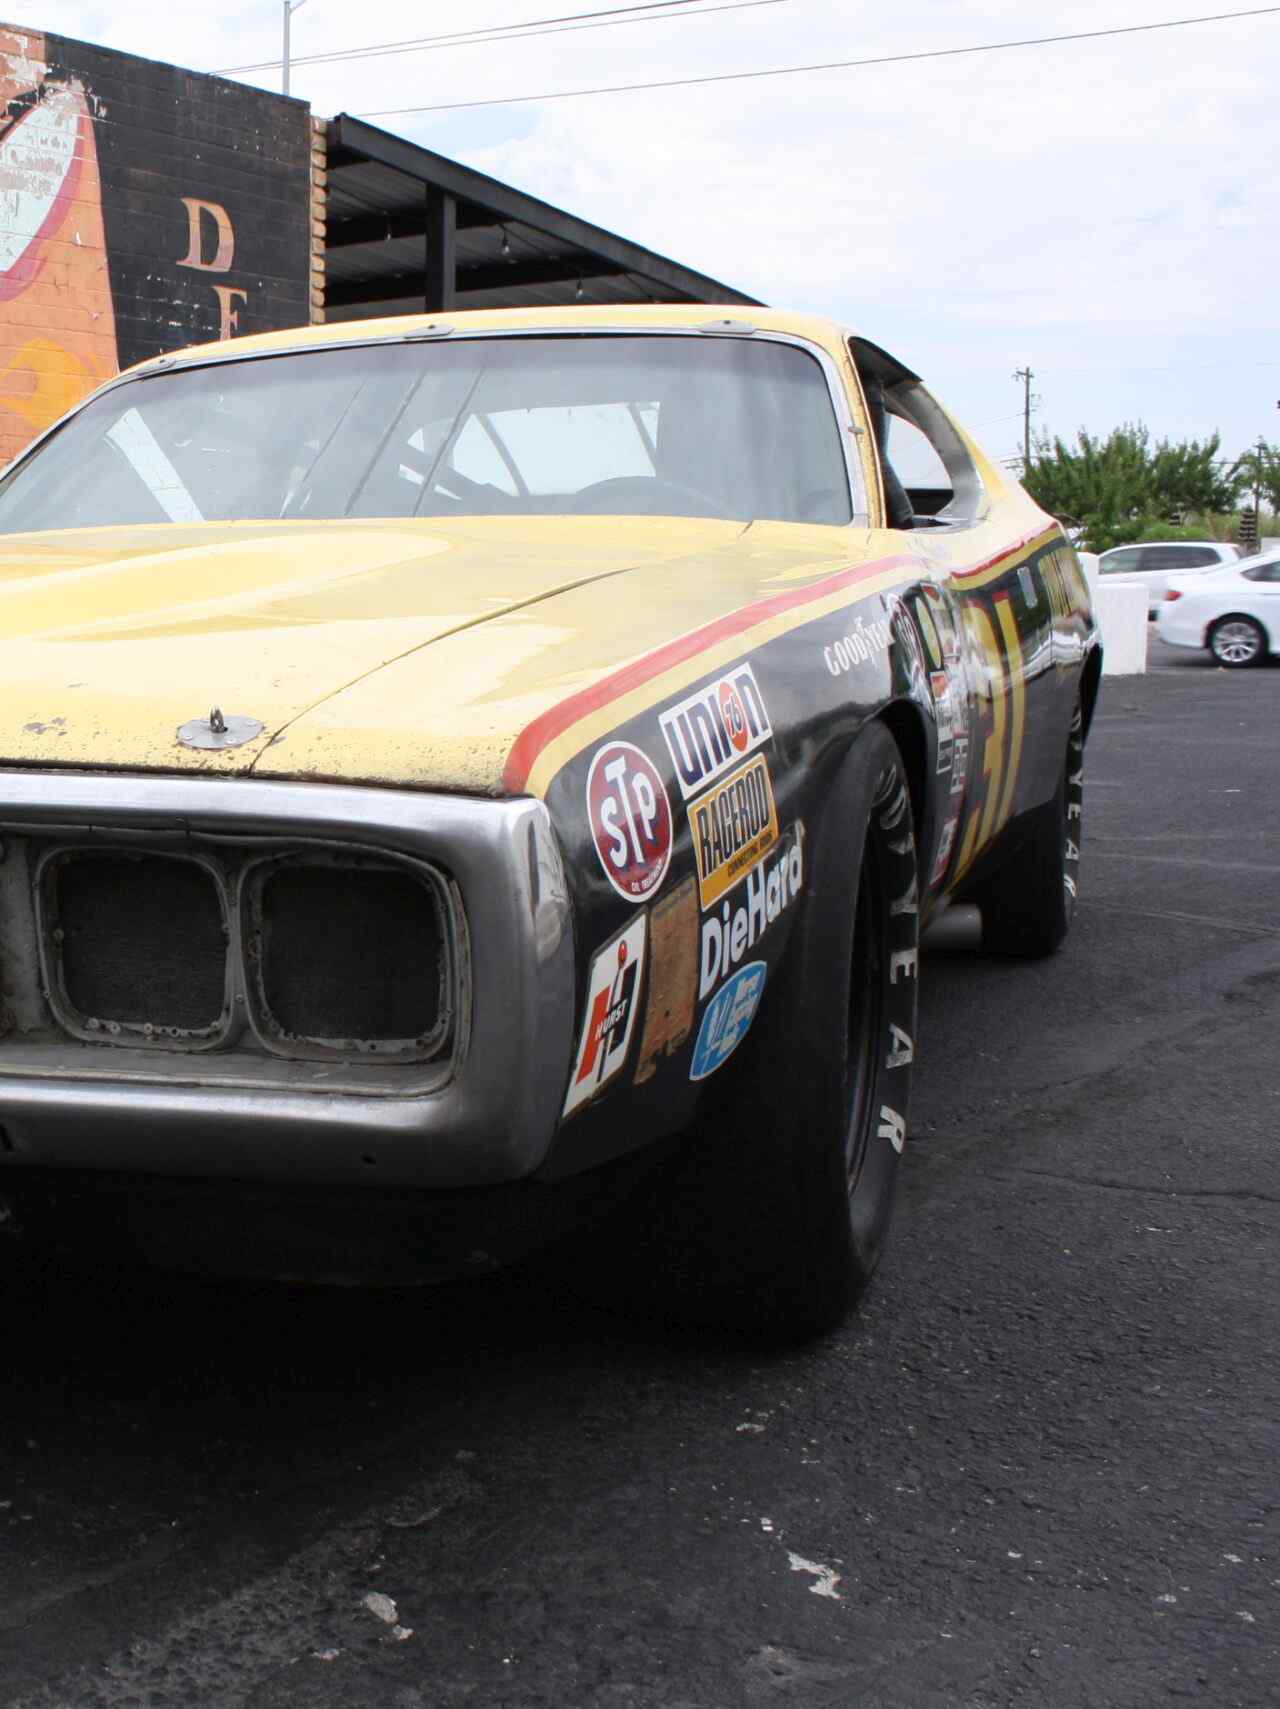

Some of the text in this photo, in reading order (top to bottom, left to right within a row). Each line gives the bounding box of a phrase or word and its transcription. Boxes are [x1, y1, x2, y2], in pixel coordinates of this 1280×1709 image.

[176, 197, 234, 273] D
[601, 755, 656, 867] STP
[699, 818, 804, 1001] DieHard
[594, 999, 627, 1042] HURST
